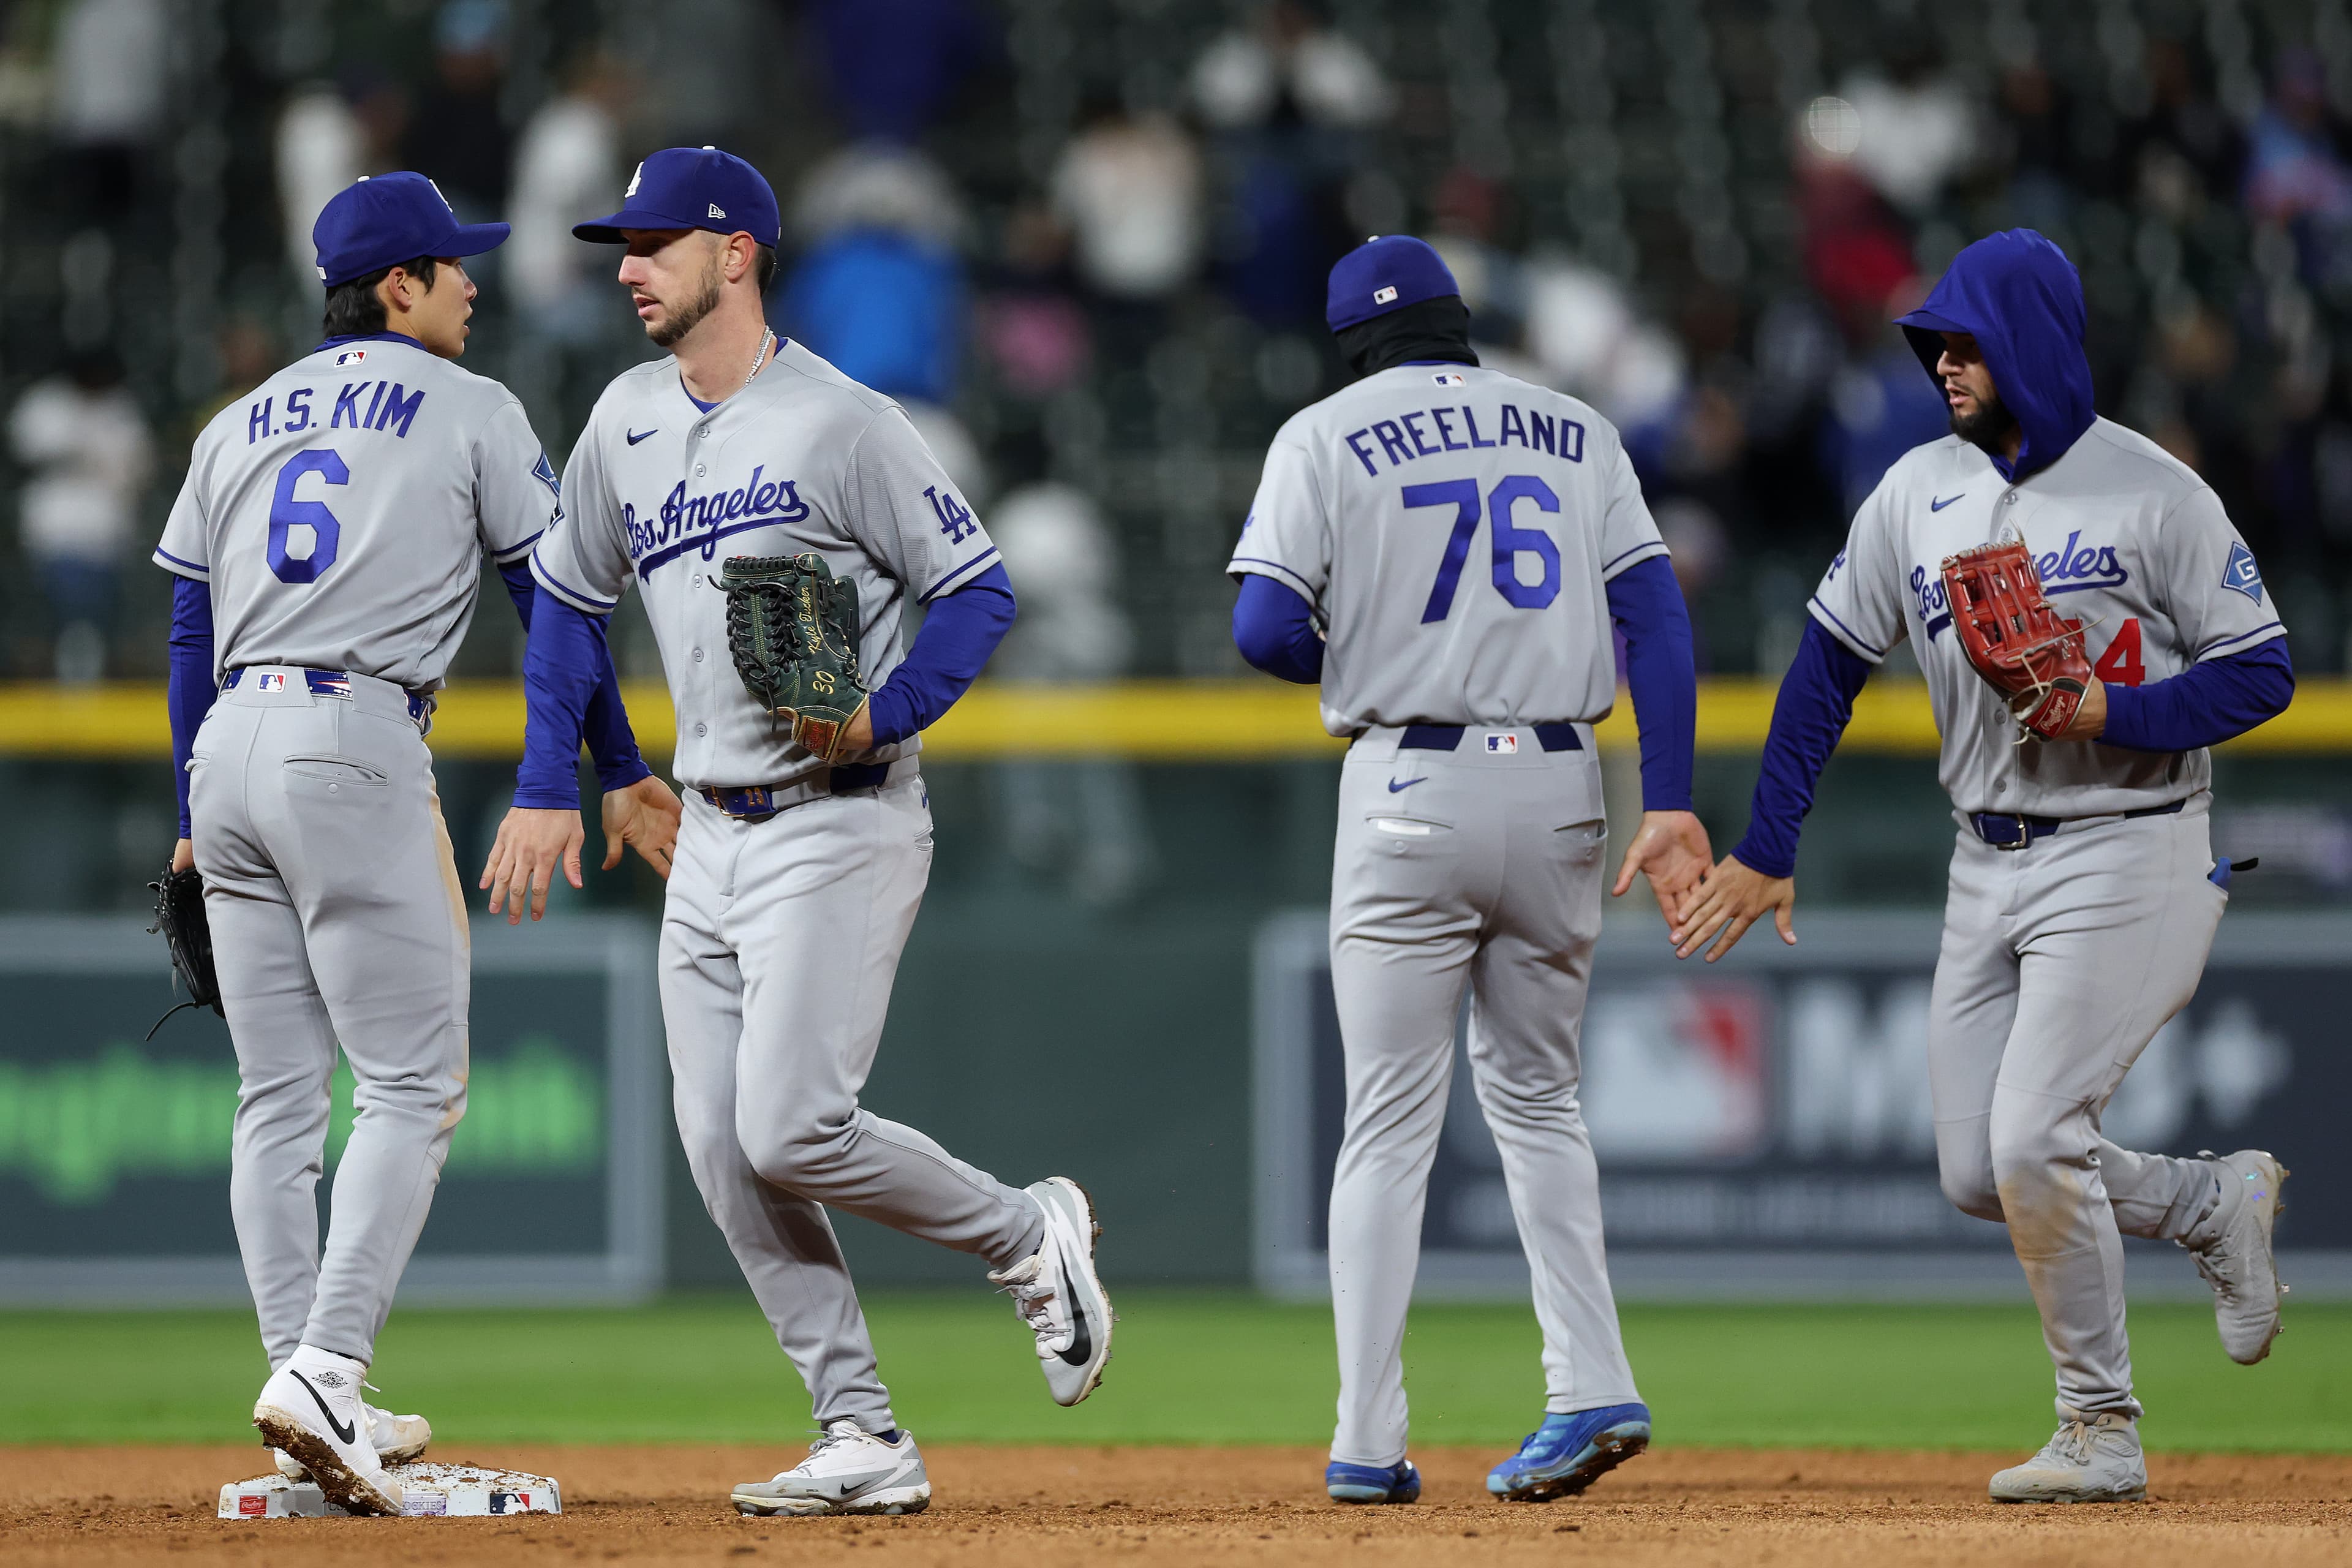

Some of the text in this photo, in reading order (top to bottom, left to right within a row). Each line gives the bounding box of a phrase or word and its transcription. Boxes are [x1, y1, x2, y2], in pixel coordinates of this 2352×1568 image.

[248, 381, 426, 445] H.S. KIM
[1344, 404, 1585, 477] FREELAND
[266, 449, 349, 584] 6
[622, 464, 801, 562] Los Angeles
[922, 484, 977, 545] LA
[1401, 475, 1561, 625] 76
[797, 586, 823, 655] Kyle Tucker
[1910, 565, 1944, 620] Los
[812, 670, 836, 695] 30
